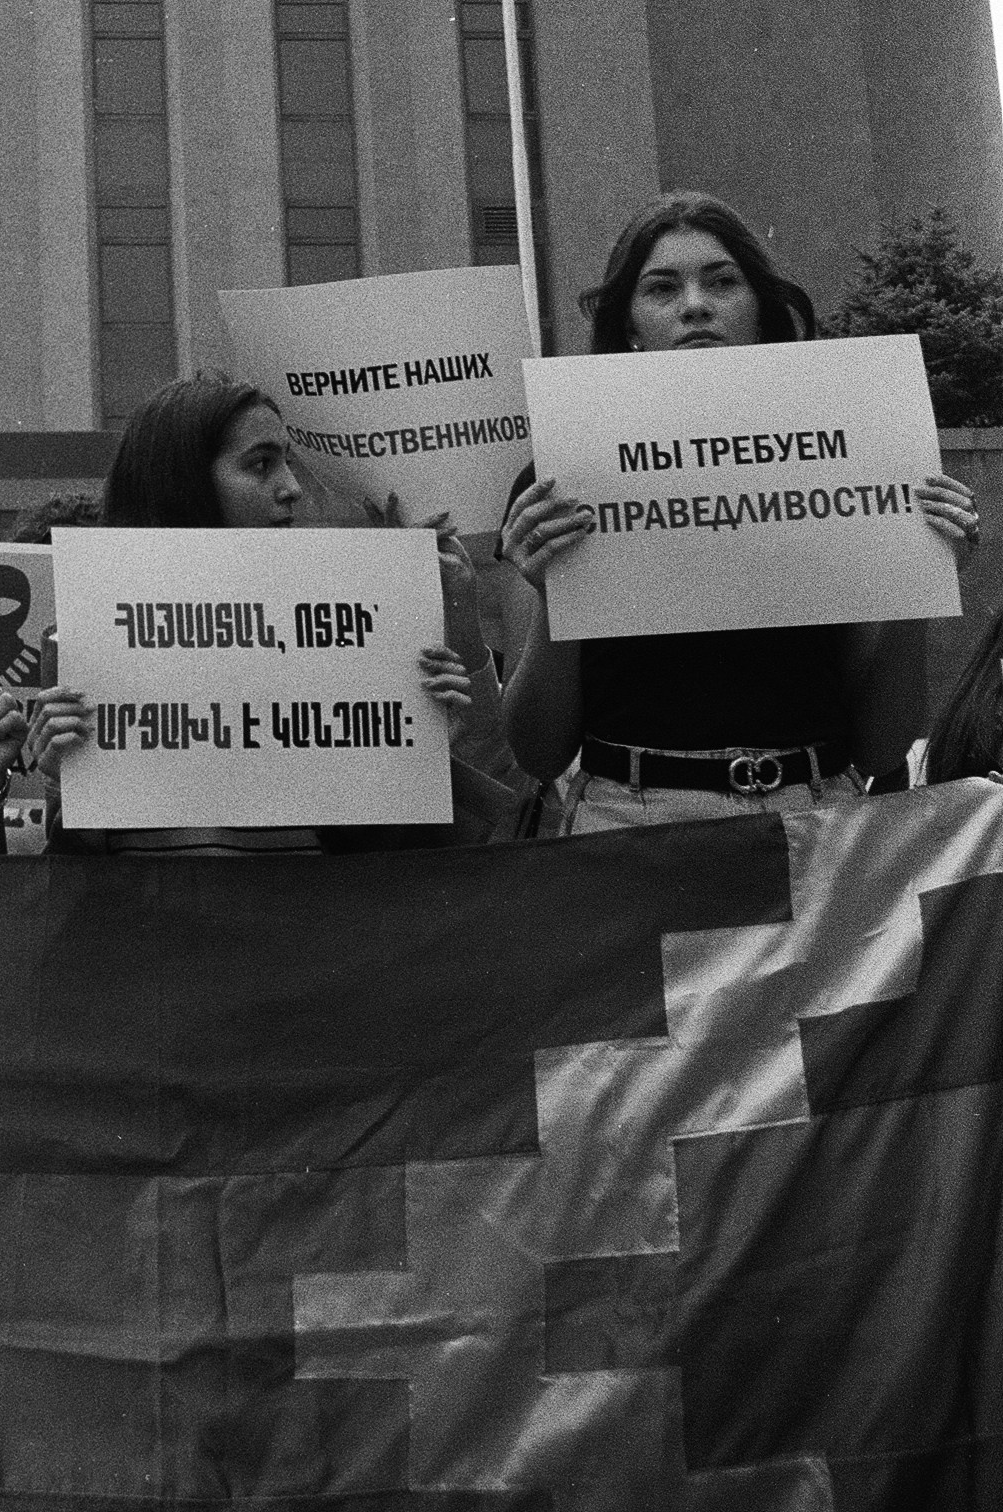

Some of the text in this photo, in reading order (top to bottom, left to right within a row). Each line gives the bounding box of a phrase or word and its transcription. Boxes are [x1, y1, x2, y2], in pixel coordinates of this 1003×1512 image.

[285, 353, 494, 397] ВЕРНИТЕ НАШИХ
[618, 429, 848, 473] МЫ ТРЕБУЕМ
[114, 602, 286, 654] ՀԱՅԱՍՏԱՆ,
[96, 702, 231, 750] ԱՐՑԱԽՆ
[242, 701, 261, 749] Է
